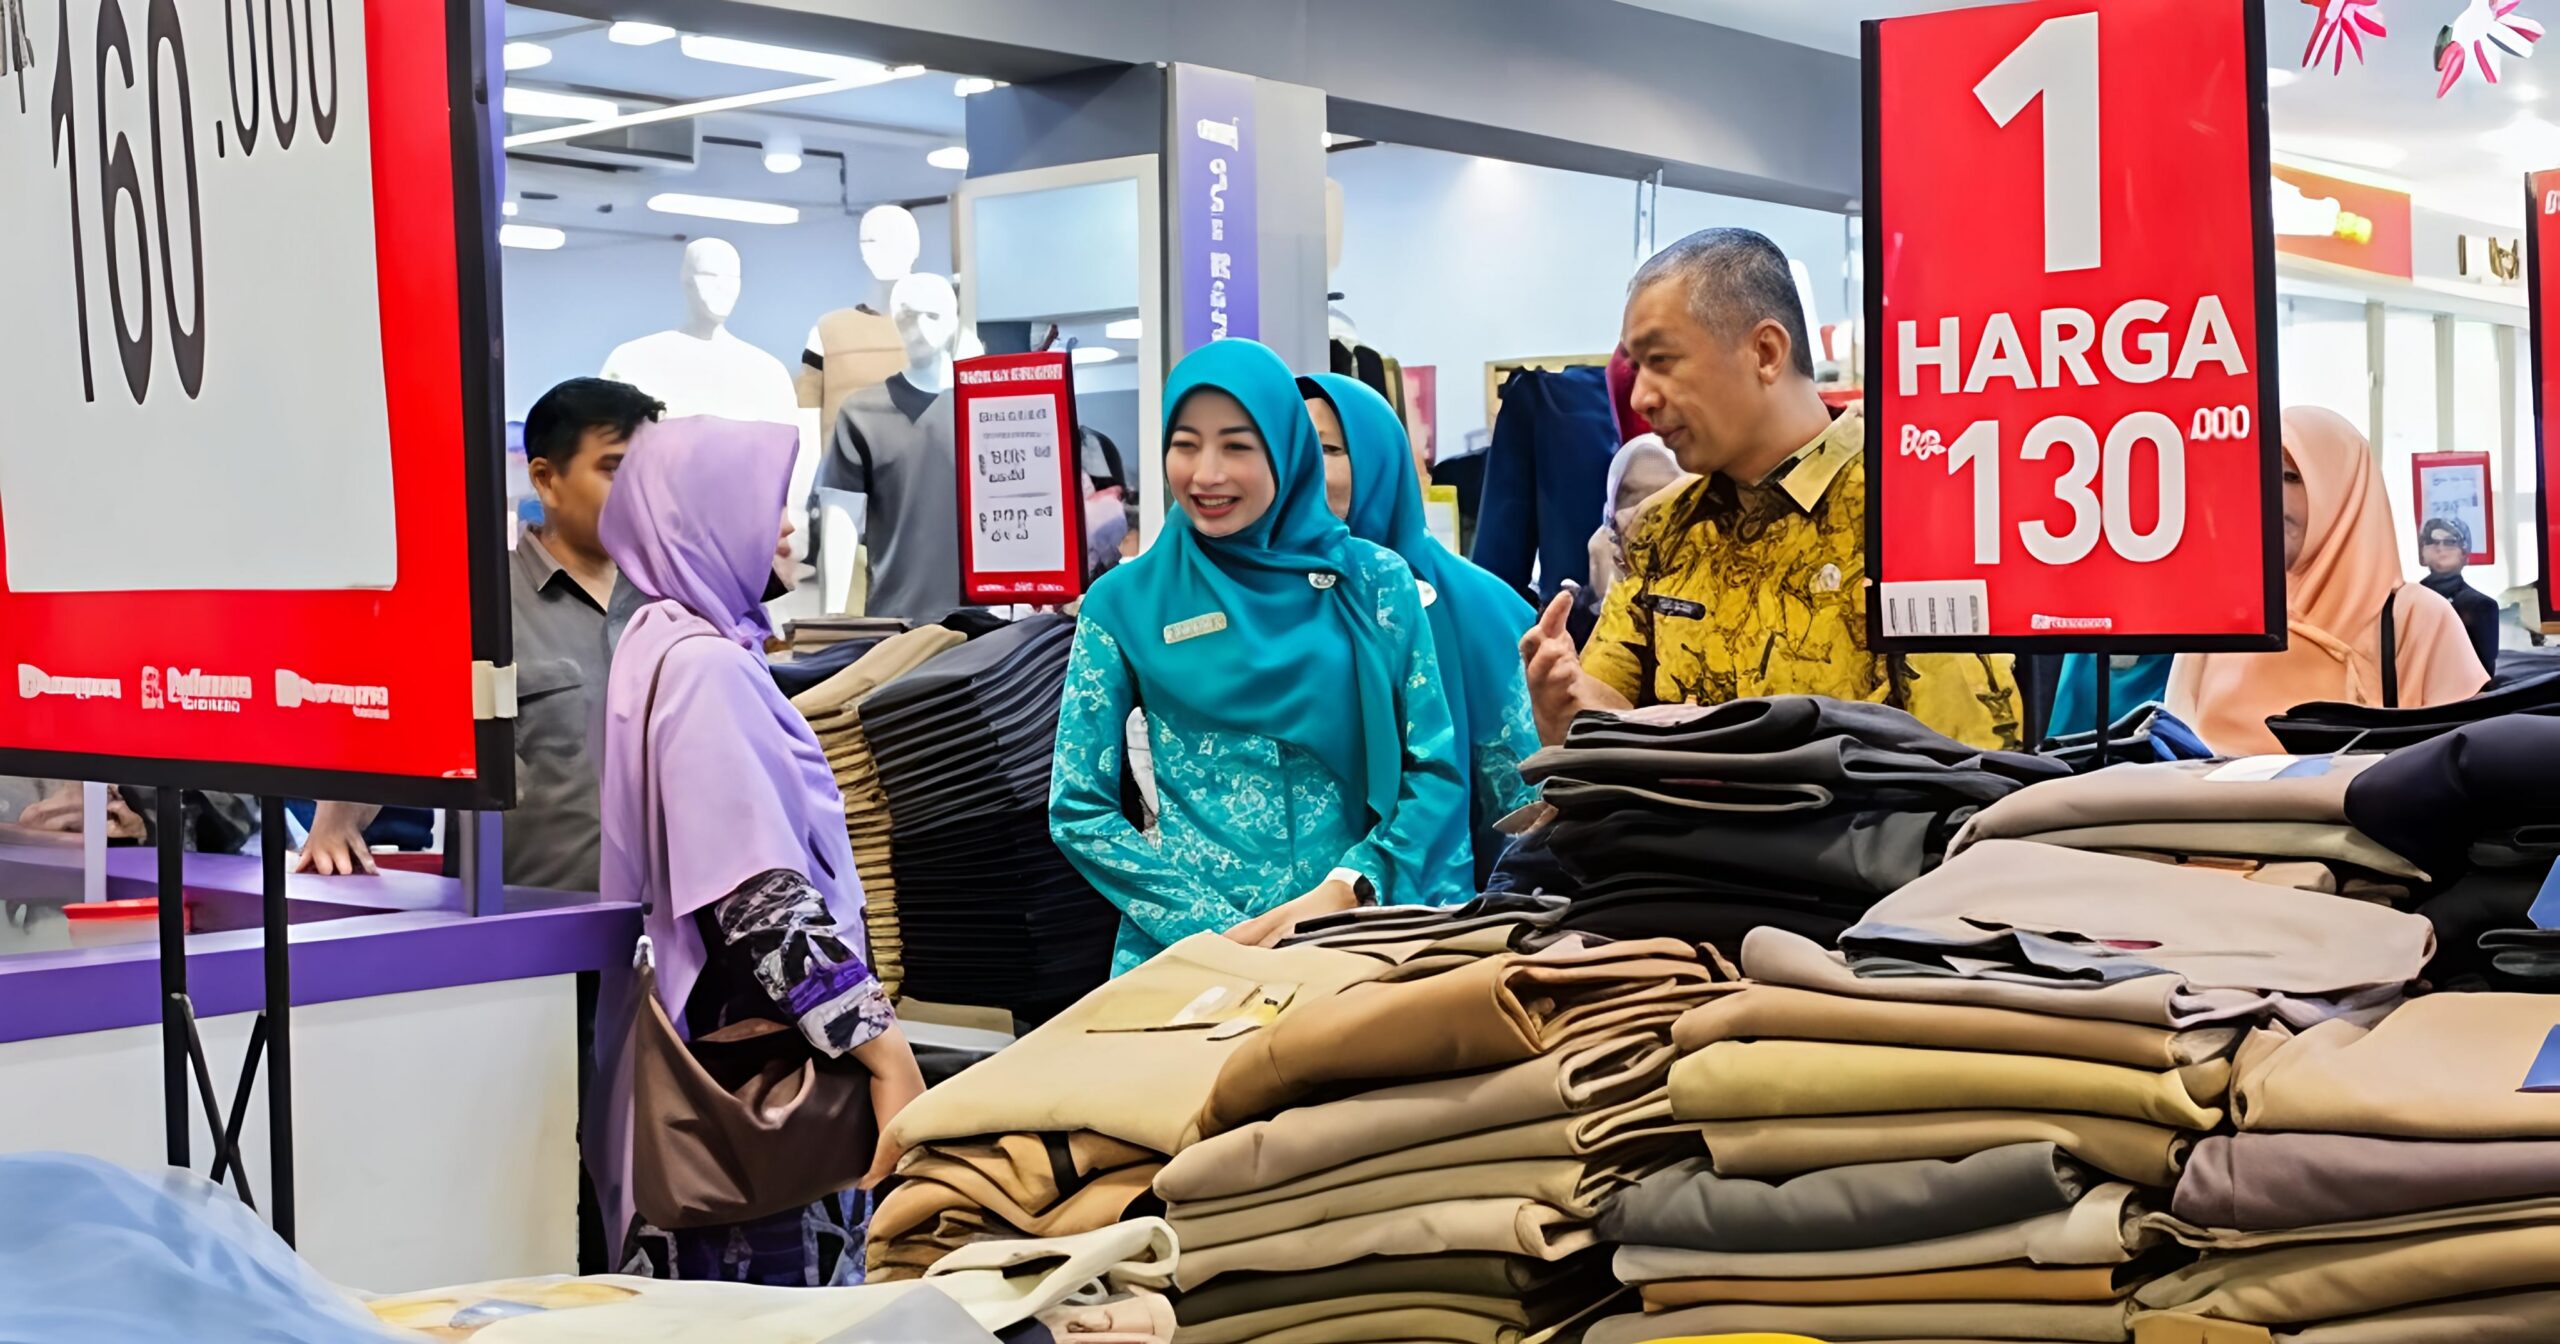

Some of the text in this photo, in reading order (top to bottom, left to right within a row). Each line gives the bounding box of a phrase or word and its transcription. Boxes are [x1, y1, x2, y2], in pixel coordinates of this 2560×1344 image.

[1973, 11, 2101, 272] 1
[1898, 295, 2249, 396] HARGA
[1948, 411, 2186, 565] 130
